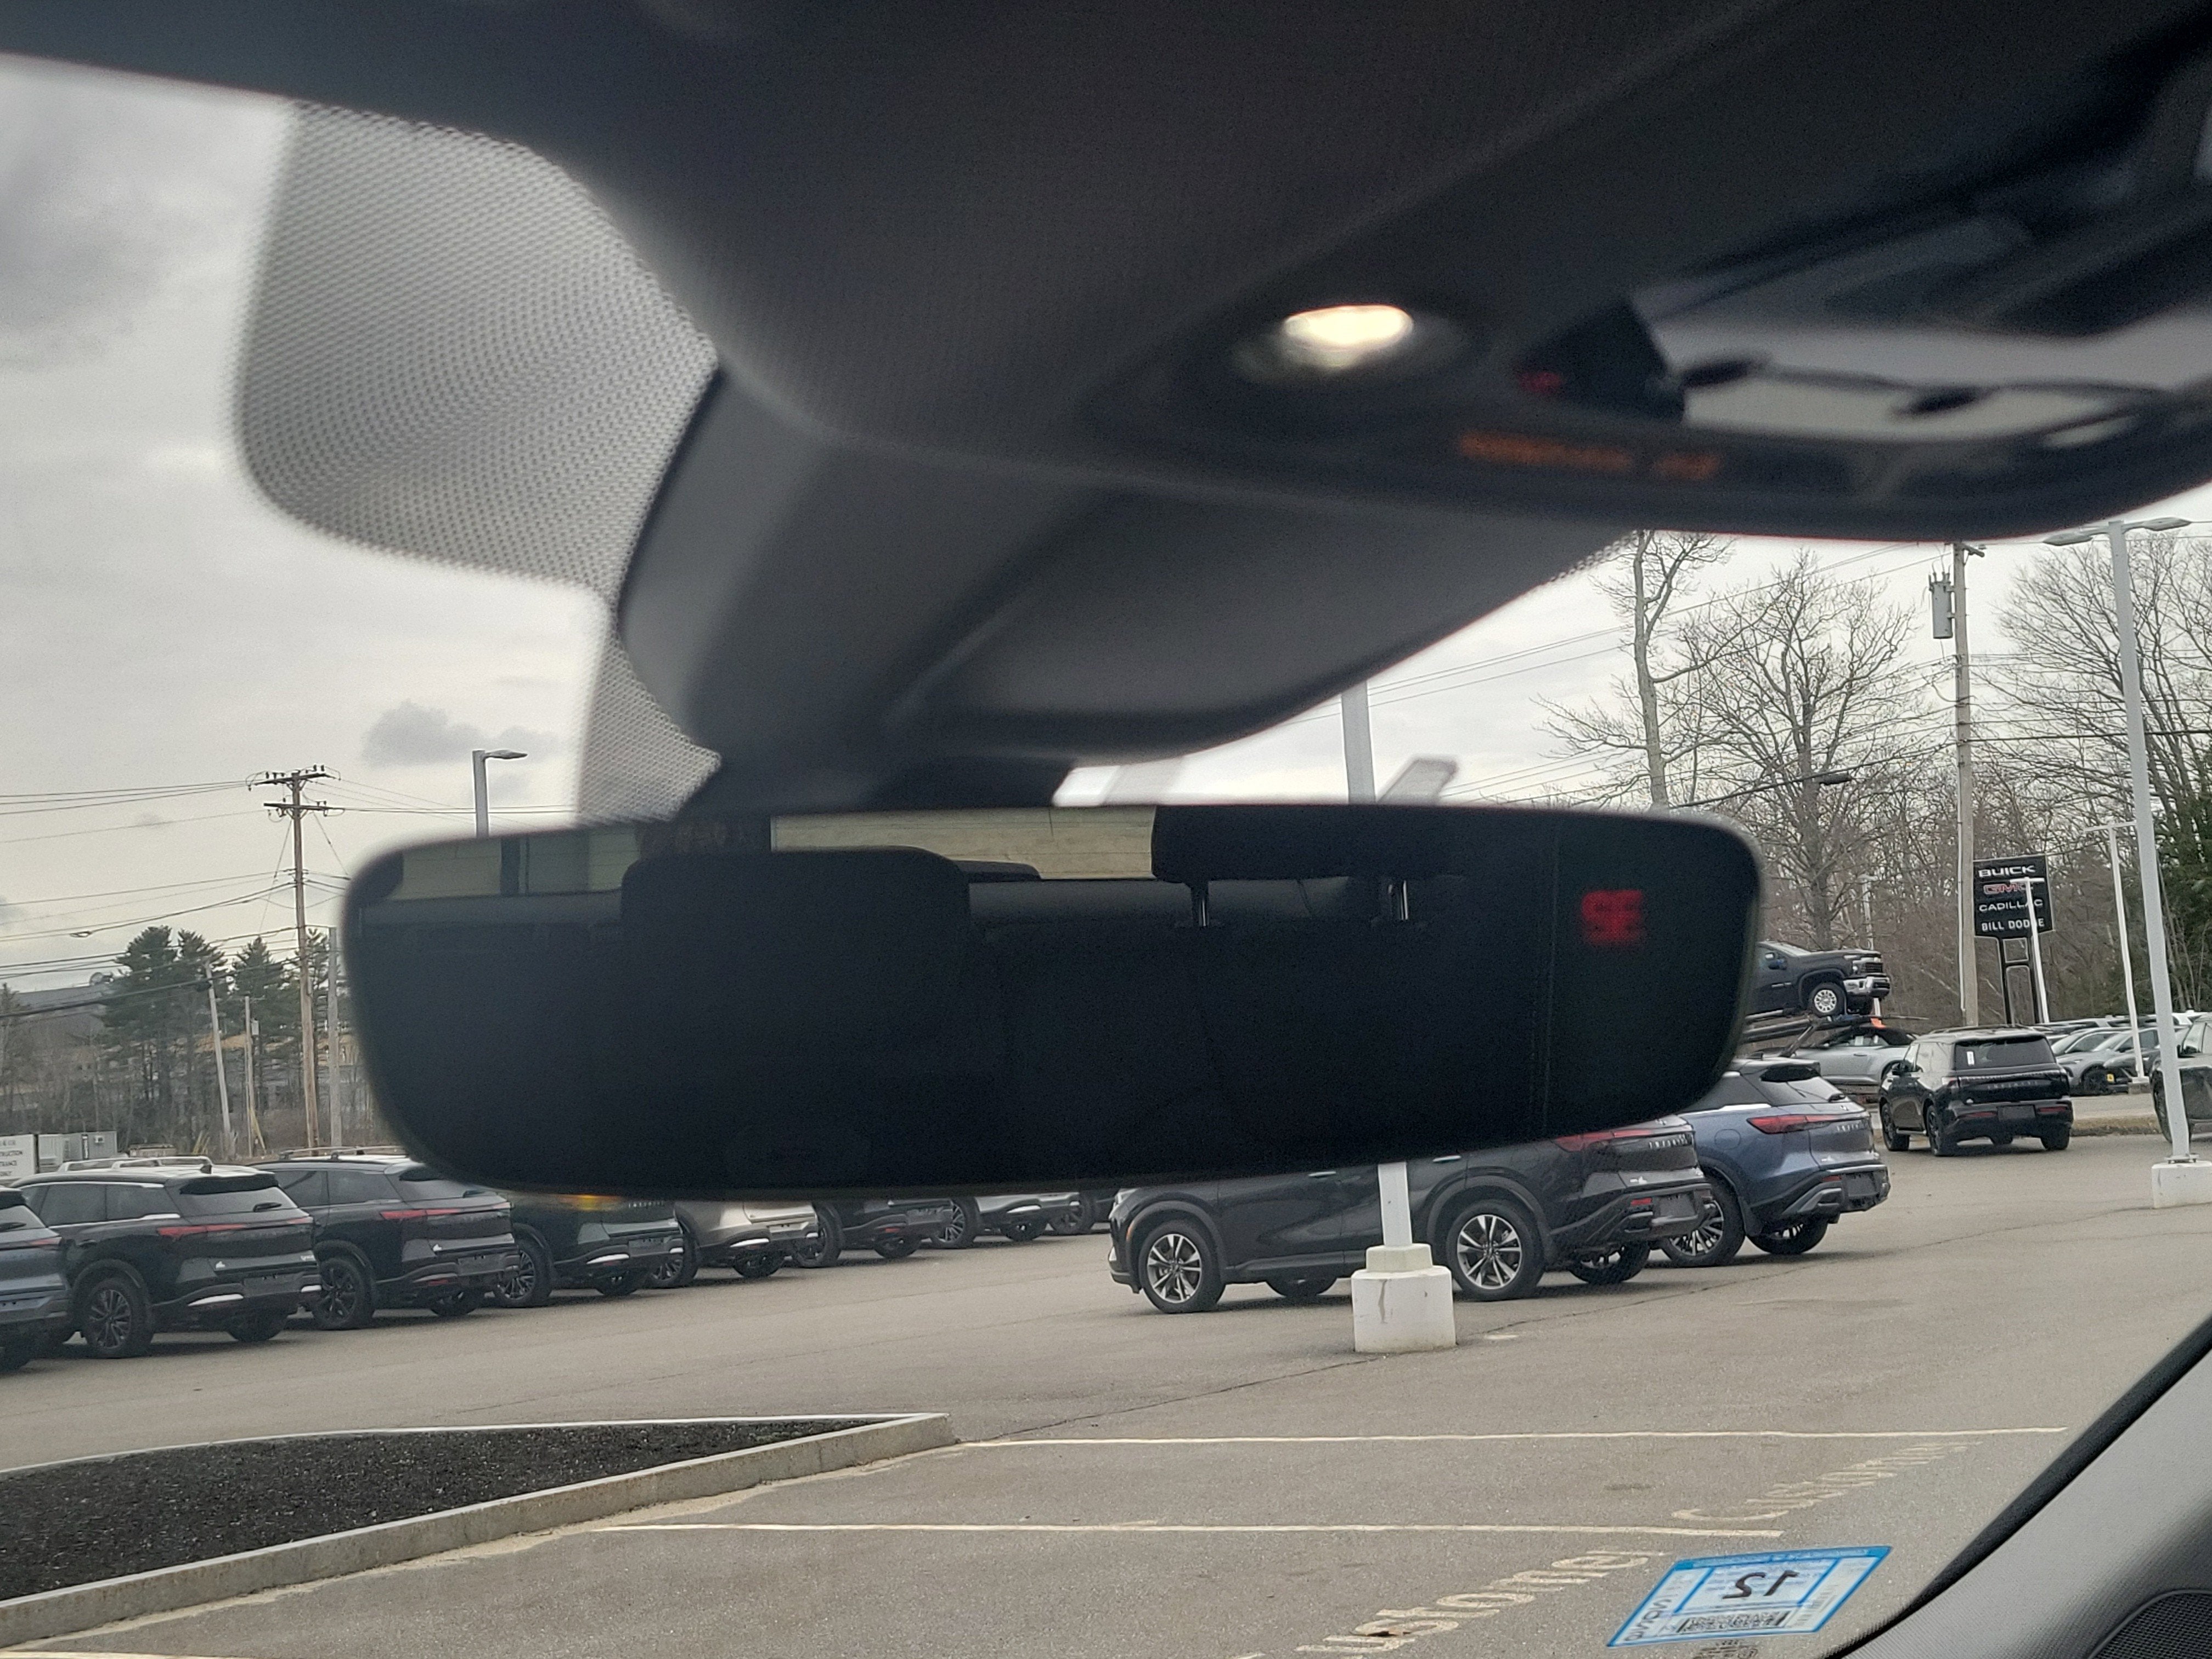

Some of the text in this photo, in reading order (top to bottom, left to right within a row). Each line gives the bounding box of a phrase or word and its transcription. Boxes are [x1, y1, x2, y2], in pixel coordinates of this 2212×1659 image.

[1978, 865, 2036, 877] BUICK
[1982, 918, 2045, 932] BILL DODE
[1229, 1550, 1671, 1659] ustomer
